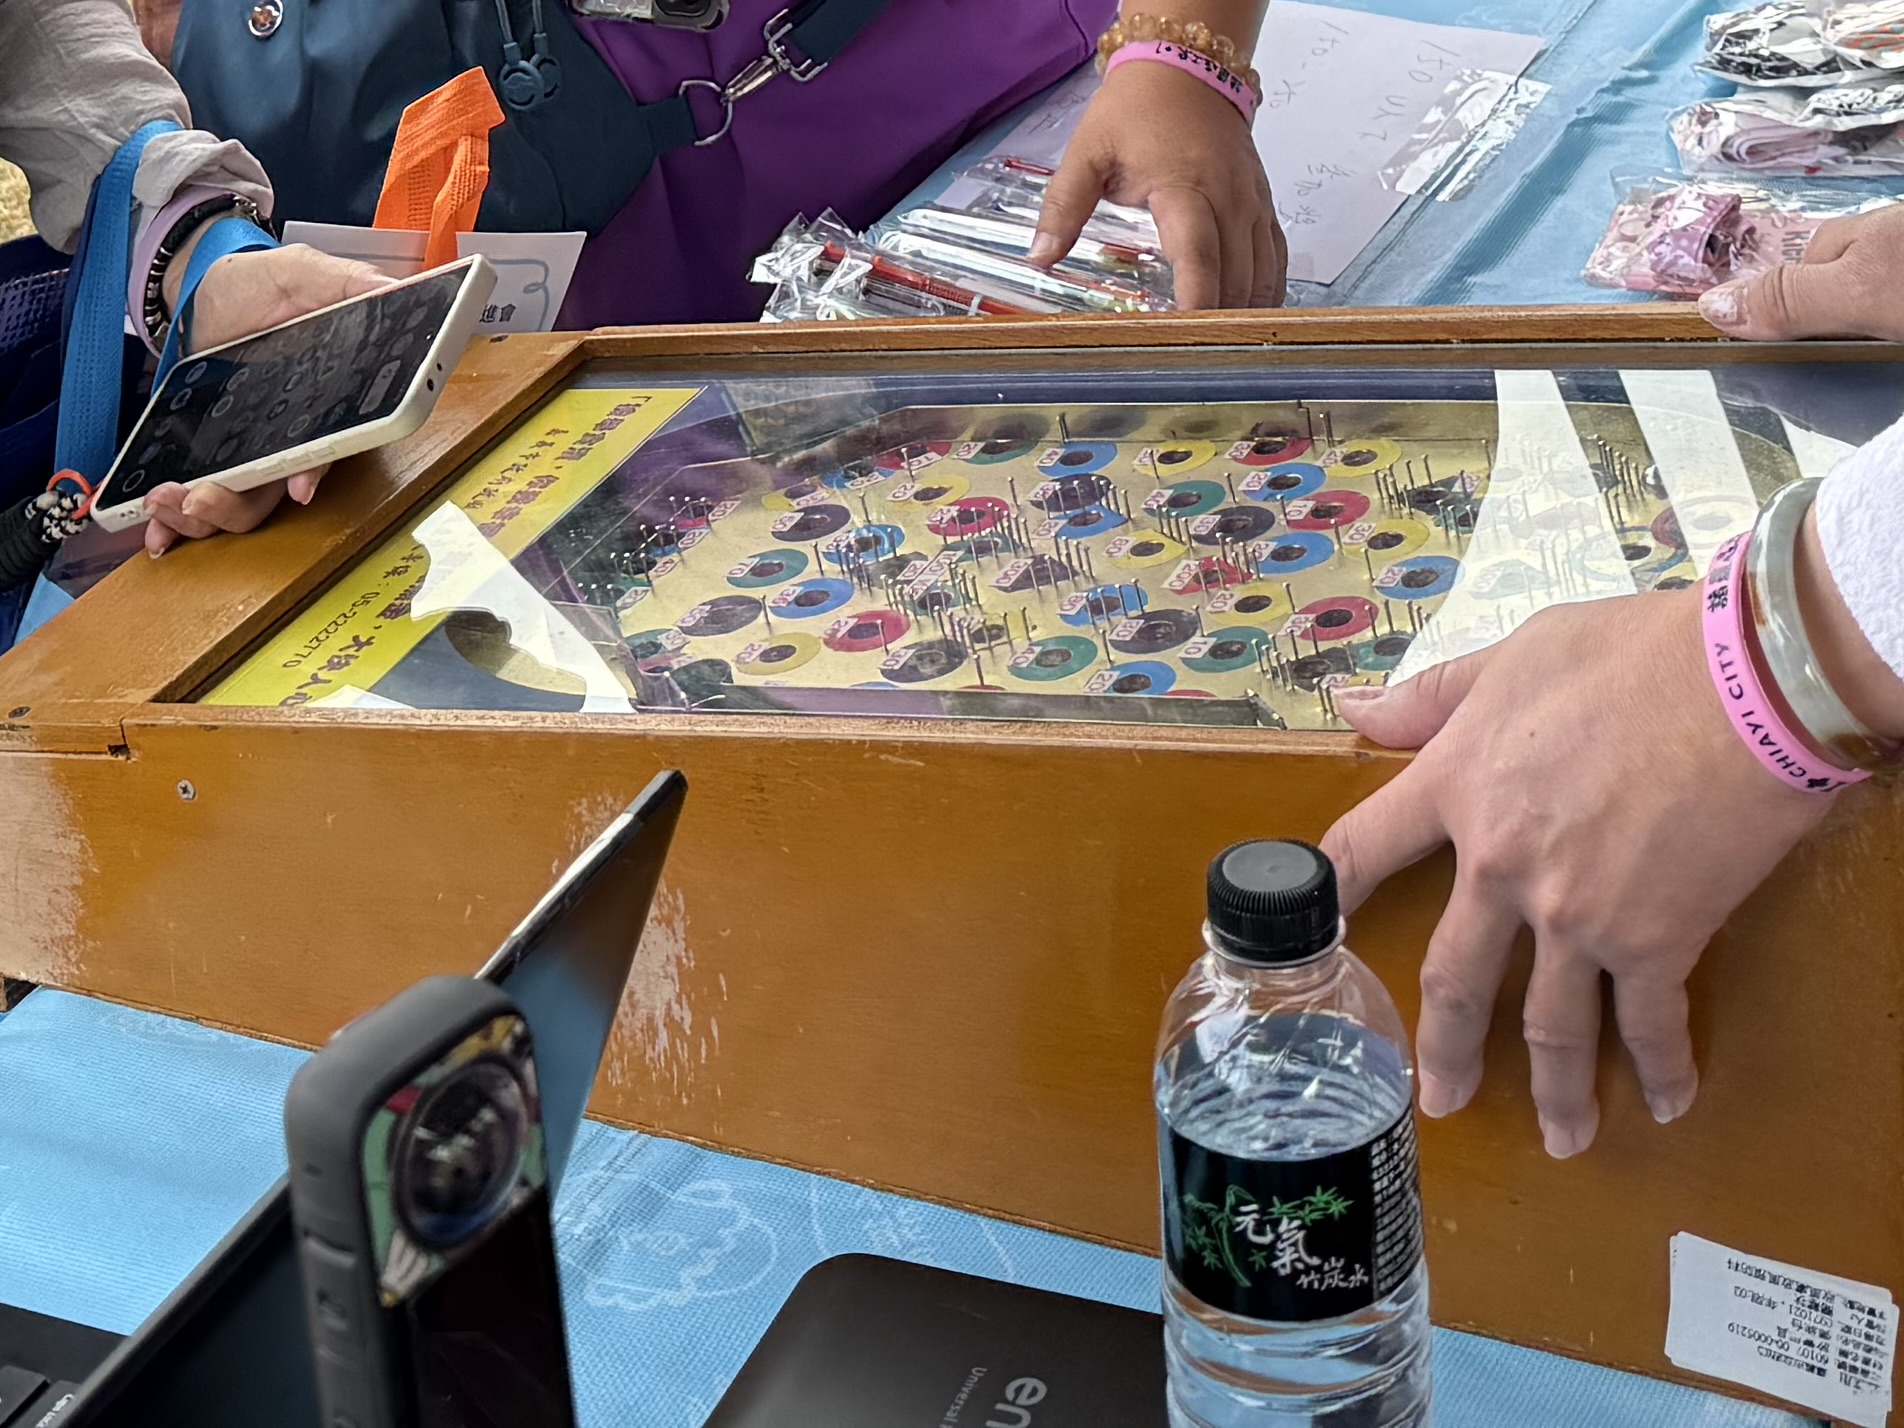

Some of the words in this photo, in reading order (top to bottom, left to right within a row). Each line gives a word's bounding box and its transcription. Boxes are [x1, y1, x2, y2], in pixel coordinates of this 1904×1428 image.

[279, 592, 382, 667] 05-2222770
[1714, 641, 1744, 700] CITY
[1741, 710, 1806, 778] CHIAYI
[1233, 1204, 1322, 1276] 元氣
[1296, 1256, 1370, 1292] 竹炭水
[941, 1367, 988, 1425] Universal
